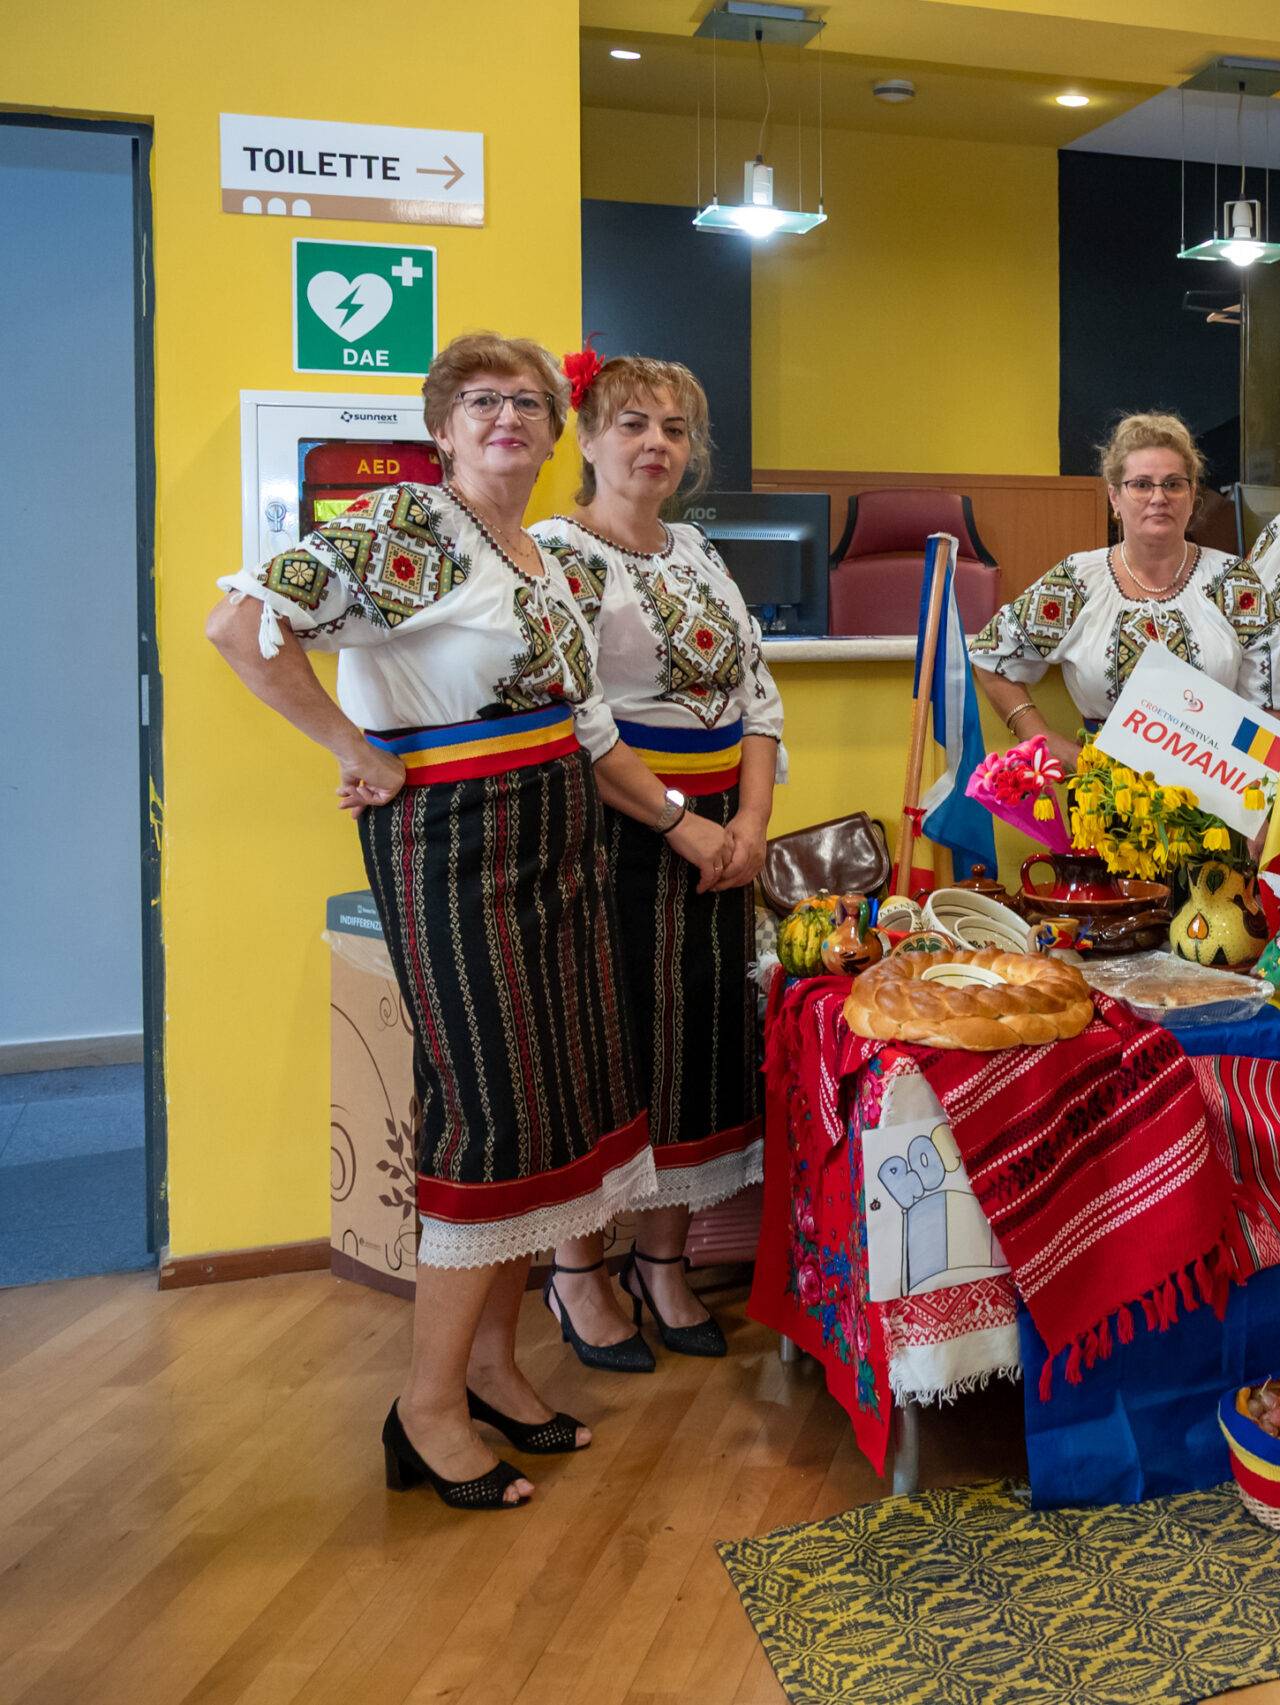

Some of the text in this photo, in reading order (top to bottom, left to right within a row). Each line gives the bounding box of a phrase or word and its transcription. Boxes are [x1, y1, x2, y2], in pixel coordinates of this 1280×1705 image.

[243, 146, 400, 181] TOILETTE
[343, 348, 390, 367] DAE
[357, 458, 400, 475] AED
[683, 508, 717, 520] AOC
[1180, 721, 1219, 750] FESTIVAL
